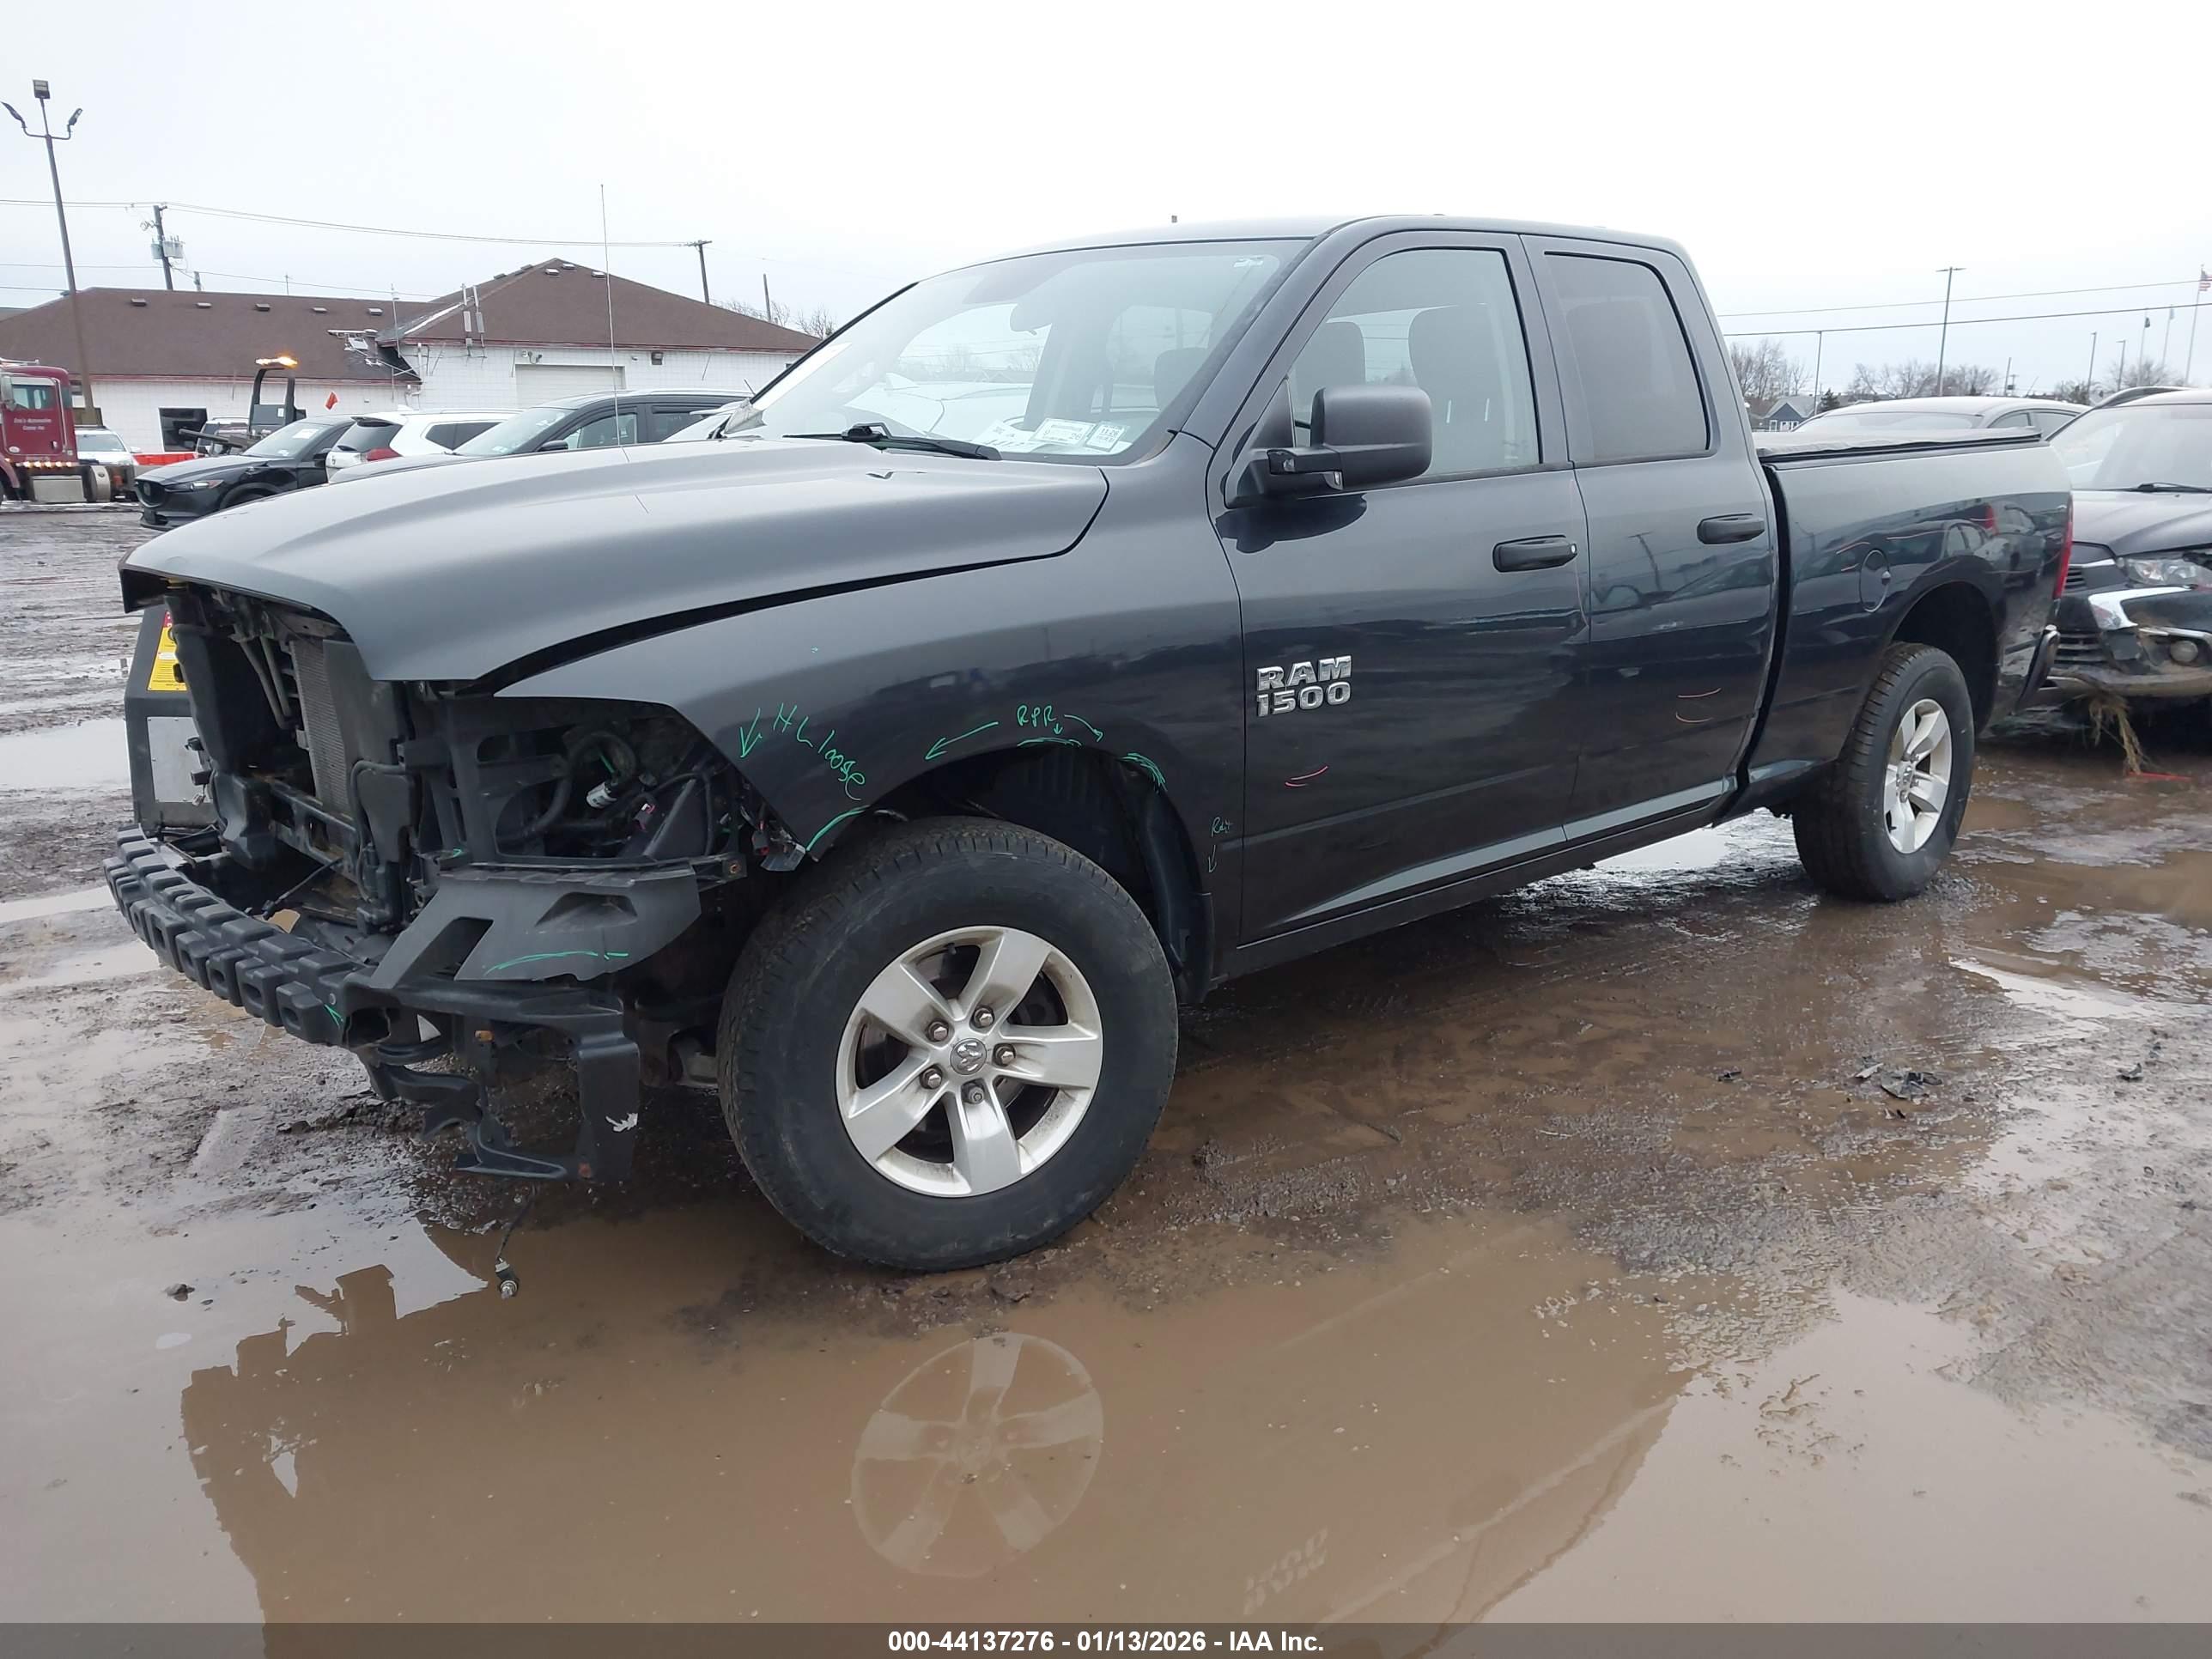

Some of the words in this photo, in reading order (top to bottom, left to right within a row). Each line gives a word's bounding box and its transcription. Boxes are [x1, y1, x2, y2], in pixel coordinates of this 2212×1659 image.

[1256, 655, 1352, 691] RAM
[1017, 705, 1057, 727] RPR
[1256, 682, 1352, 717] 1500
